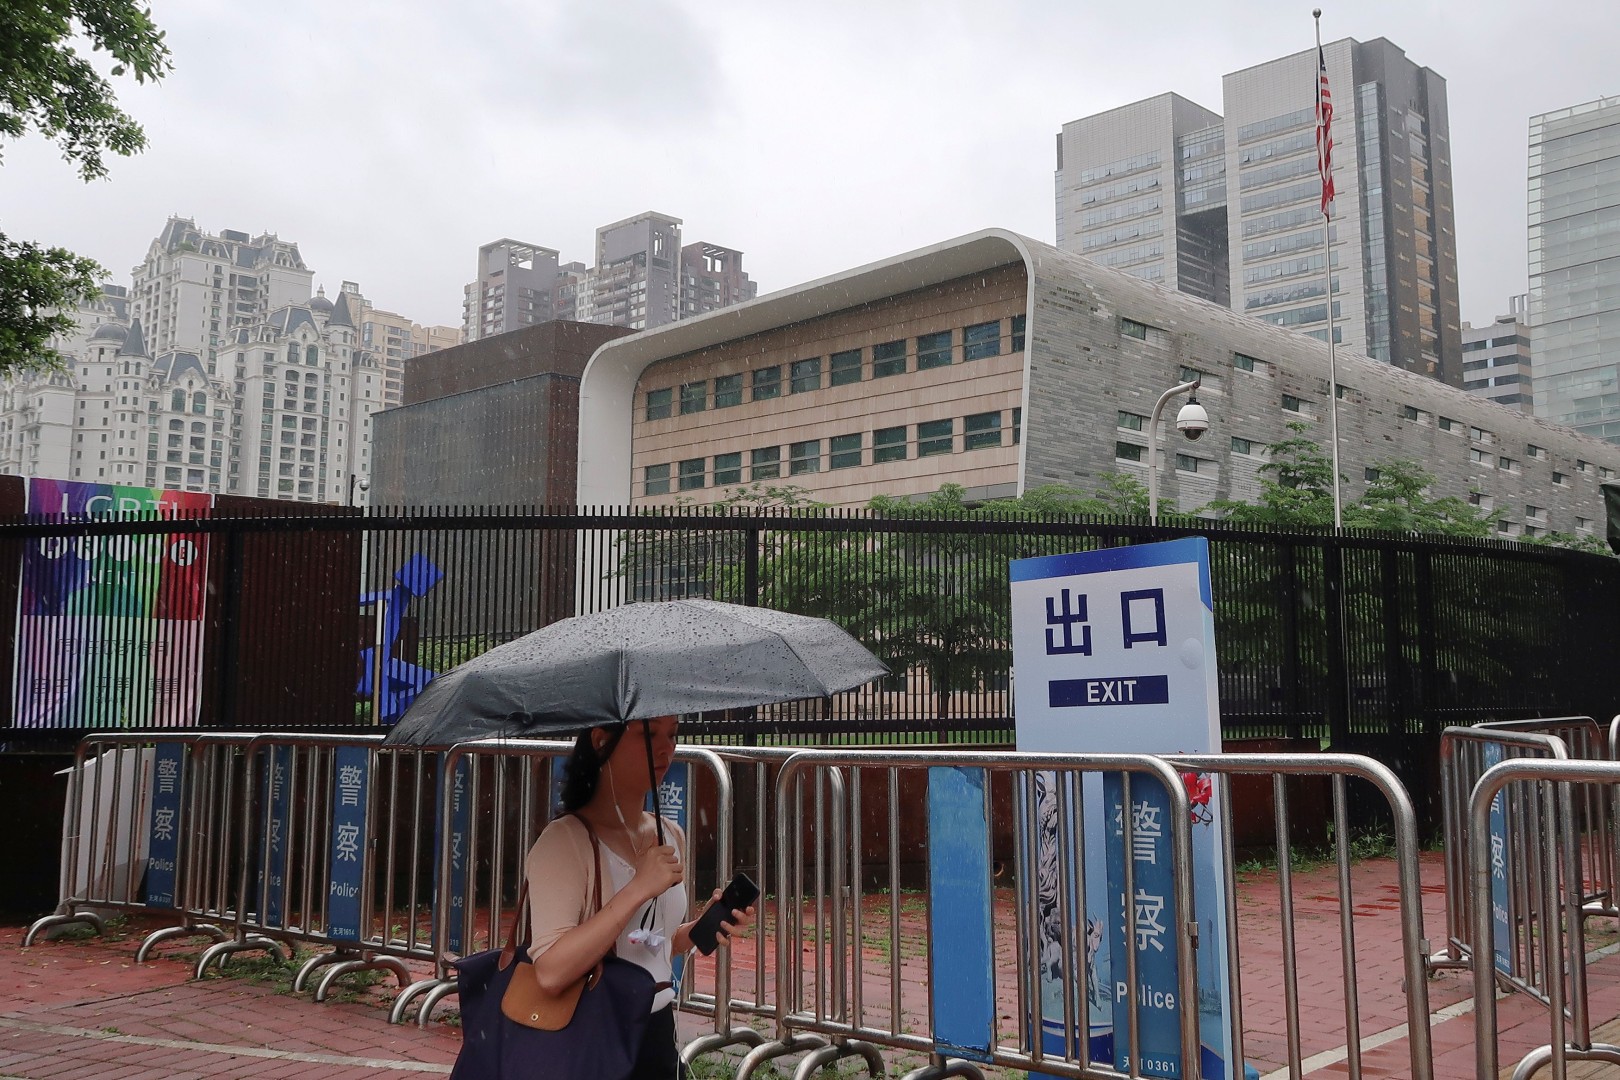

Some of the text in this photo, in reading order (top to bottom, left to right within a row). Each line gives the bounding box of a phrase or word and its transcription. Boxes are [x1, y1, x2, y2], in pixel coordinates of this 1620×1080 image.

[1045, 588, 1168, 656] 出口
[1086, 680, 1137, 703] EXIT
[153, 758, 178, 841] 警察
[336, 765, 362, 862] 警察
[149, 857, 174, 871] Police
[258, 870, 282, 886] Pice
[1114, 800, 1167, 952] 警察
[1116, 981, 1176, 1011] Plice
[1123, 1056, 1176, 1073] 天0361
